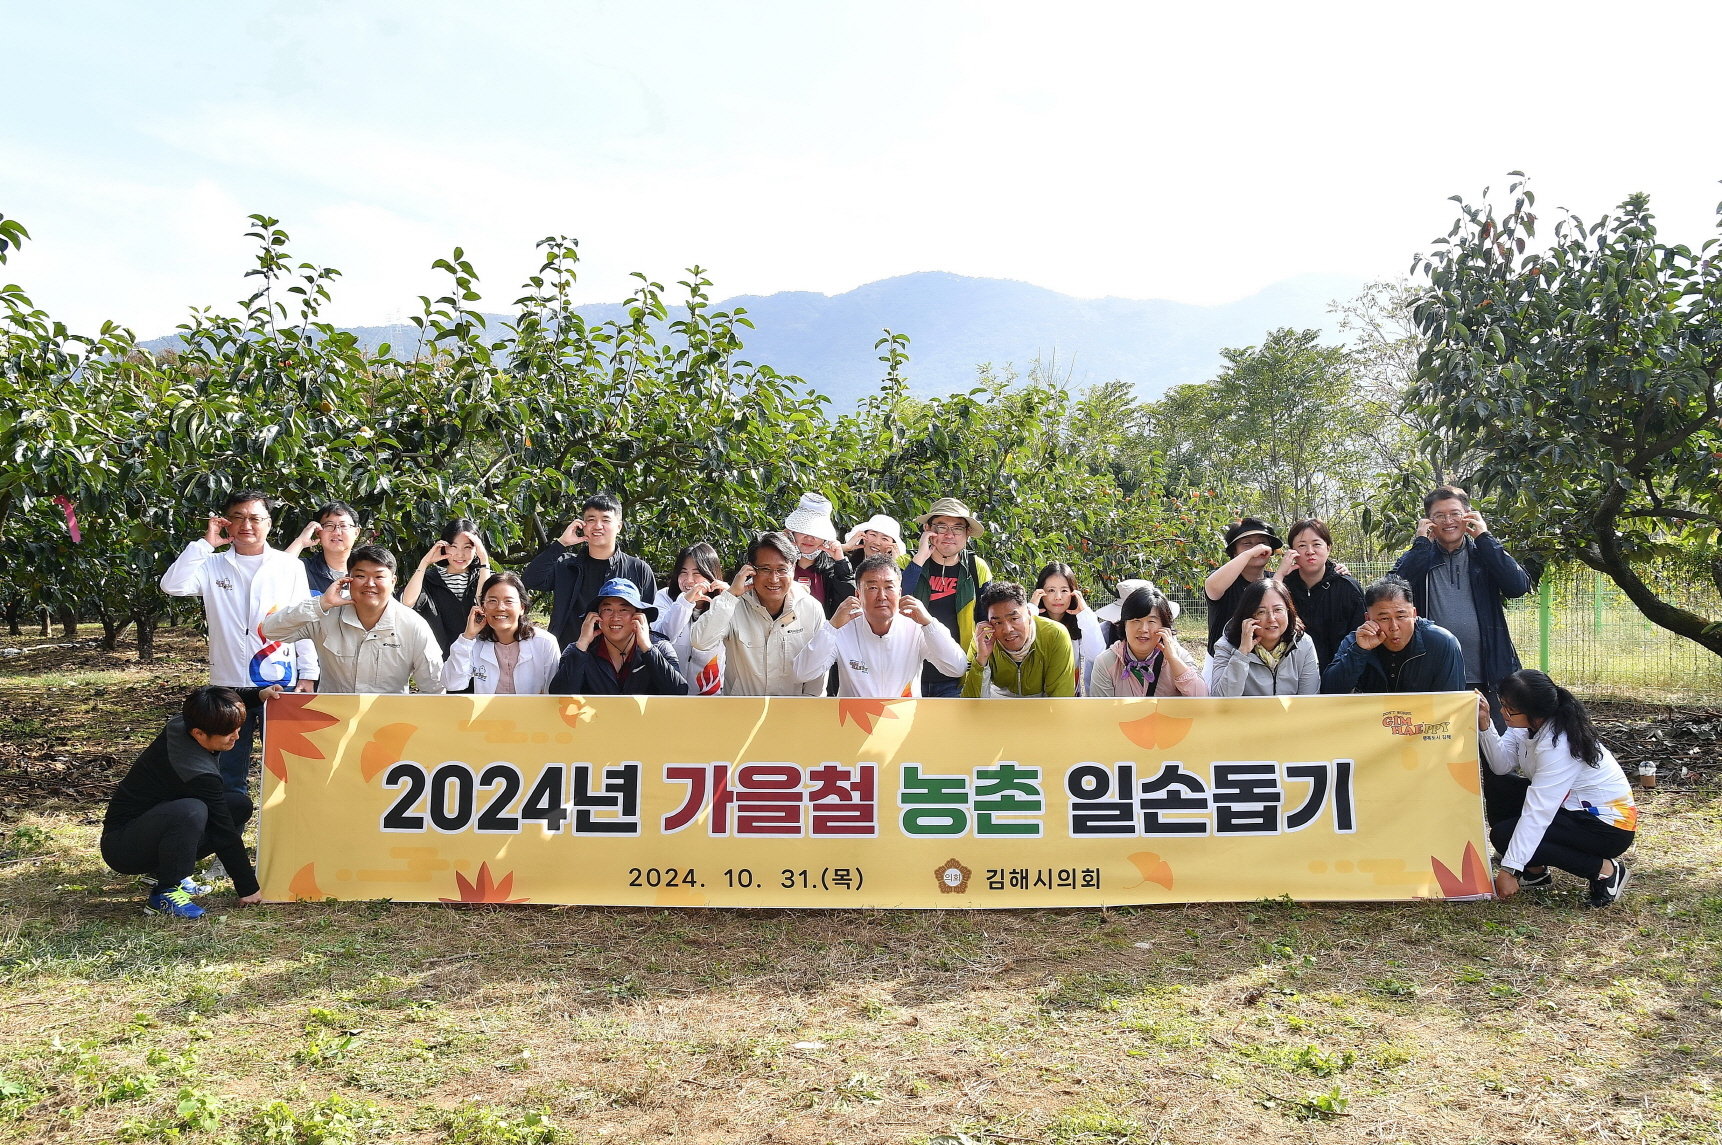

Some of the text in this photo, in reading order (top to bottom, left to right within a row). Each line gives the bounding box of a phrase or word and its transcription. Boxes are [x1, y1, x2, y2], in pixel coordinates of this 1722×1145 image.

[928, 575, 958, 592] NIKE
[1382, 715, 1412, 727] GIM
[382, 761, 1354, 836] 2024년 가을철 농촌 일손돕기
[628, 867, 864, 891] 2024. 10. 31.(목)
[944, 873, 961, 882] 의회
[985, 868, 1101, 890] 김해시의회
